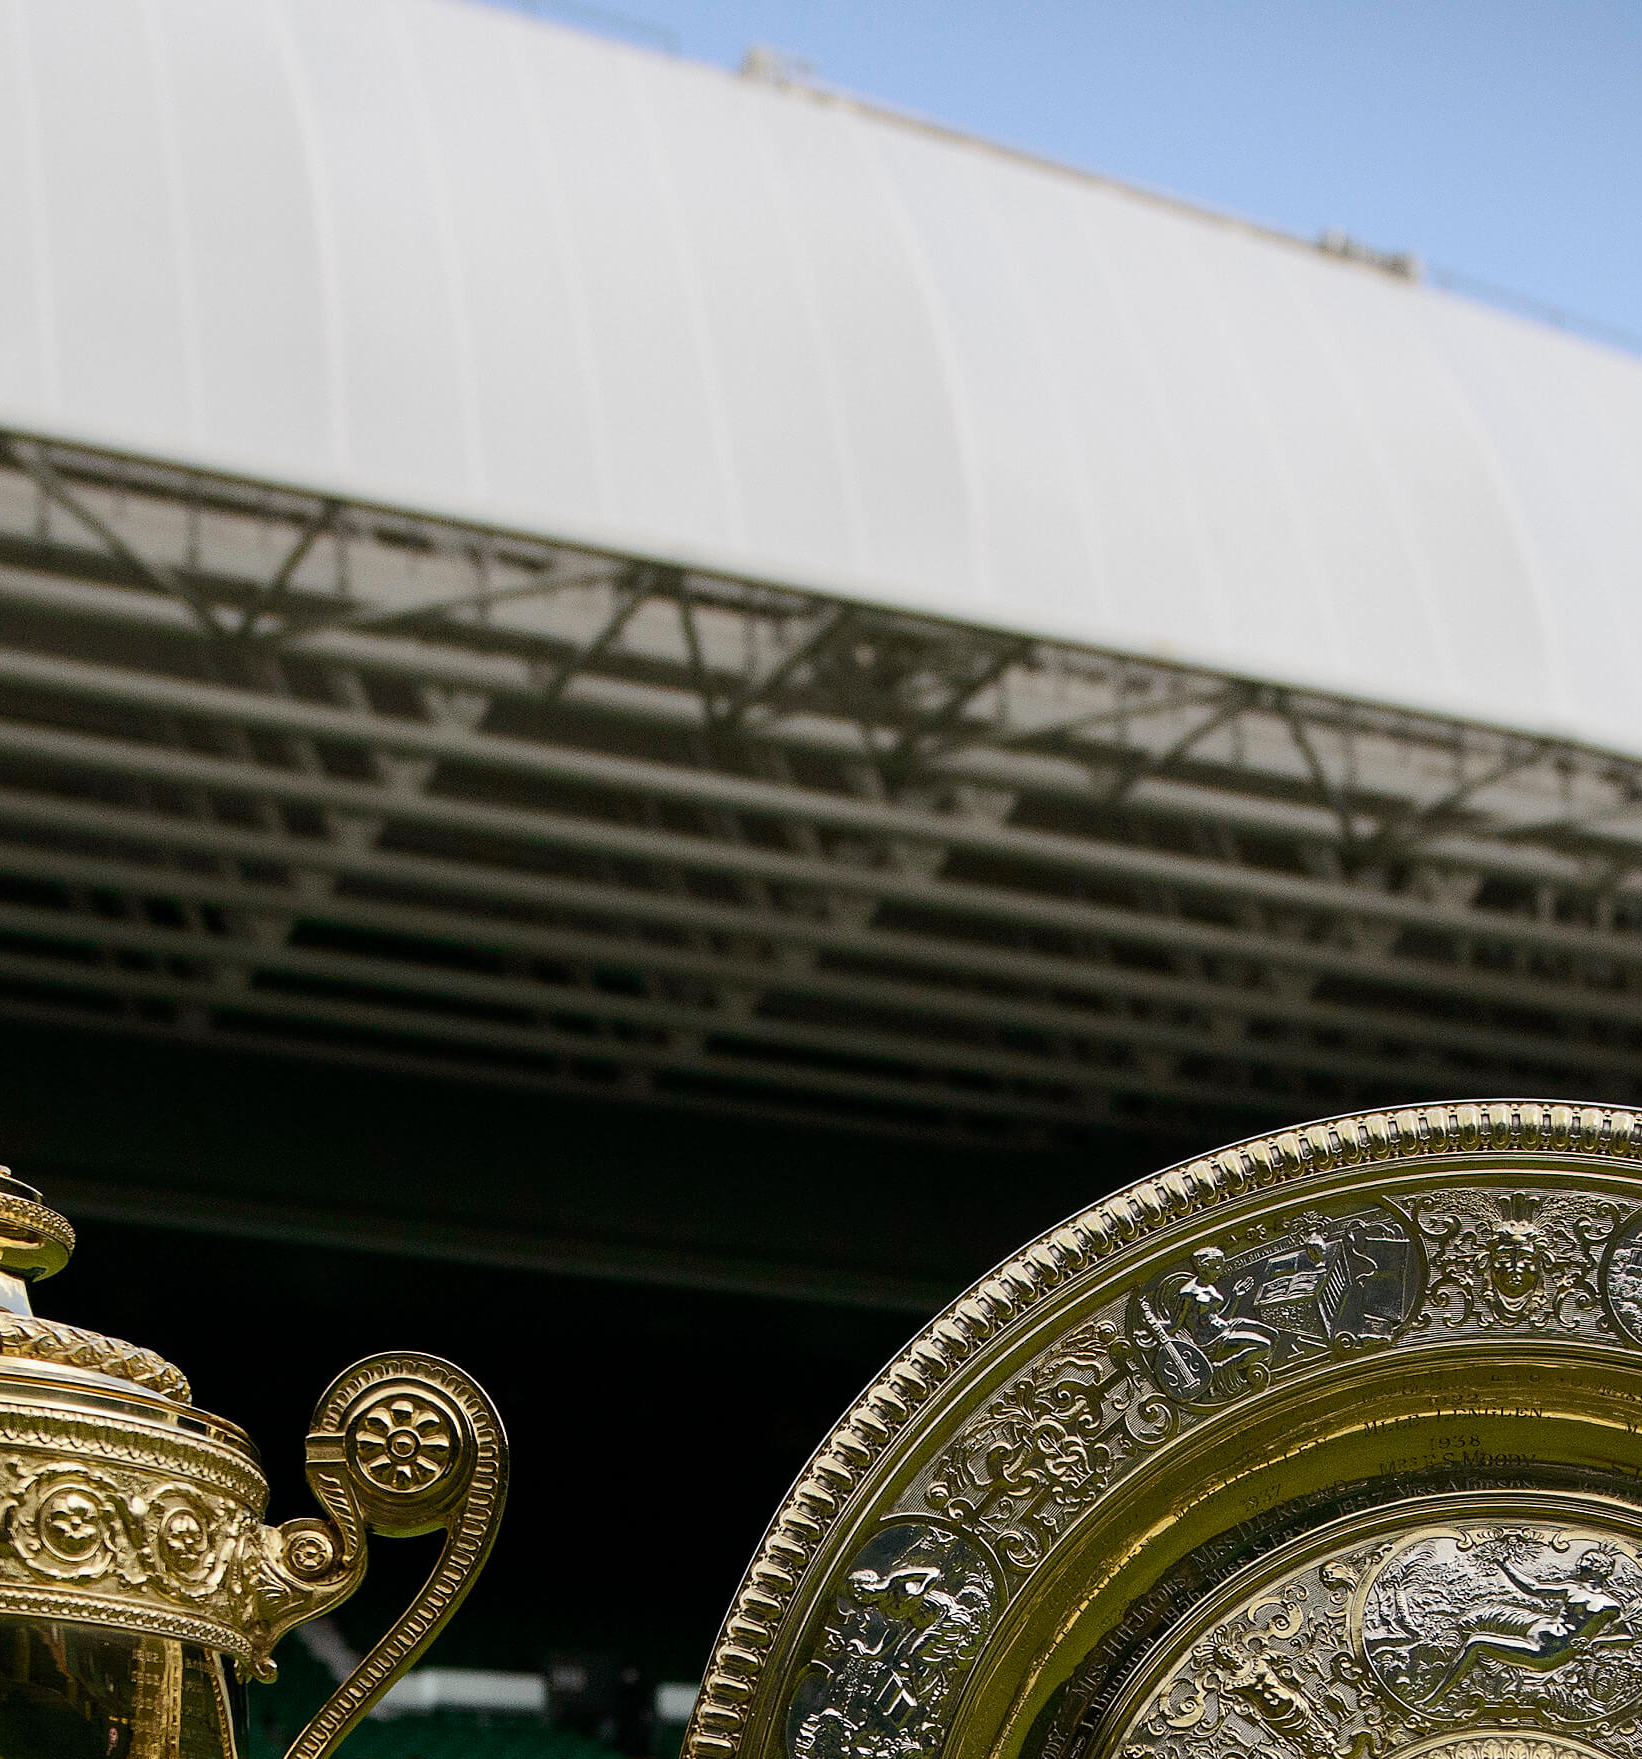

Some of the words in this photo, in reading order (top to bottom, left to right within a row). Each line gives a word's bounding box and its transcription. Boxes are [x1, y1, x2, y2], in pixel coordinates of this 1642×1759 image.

[1428, 1431, 1482, 1453] 1938
[1188, 1526, 1240, 1573] MISS
[1205, 1548, 1249, 1588] MISS
[1070, 1653, 1111, 1701] MISS
